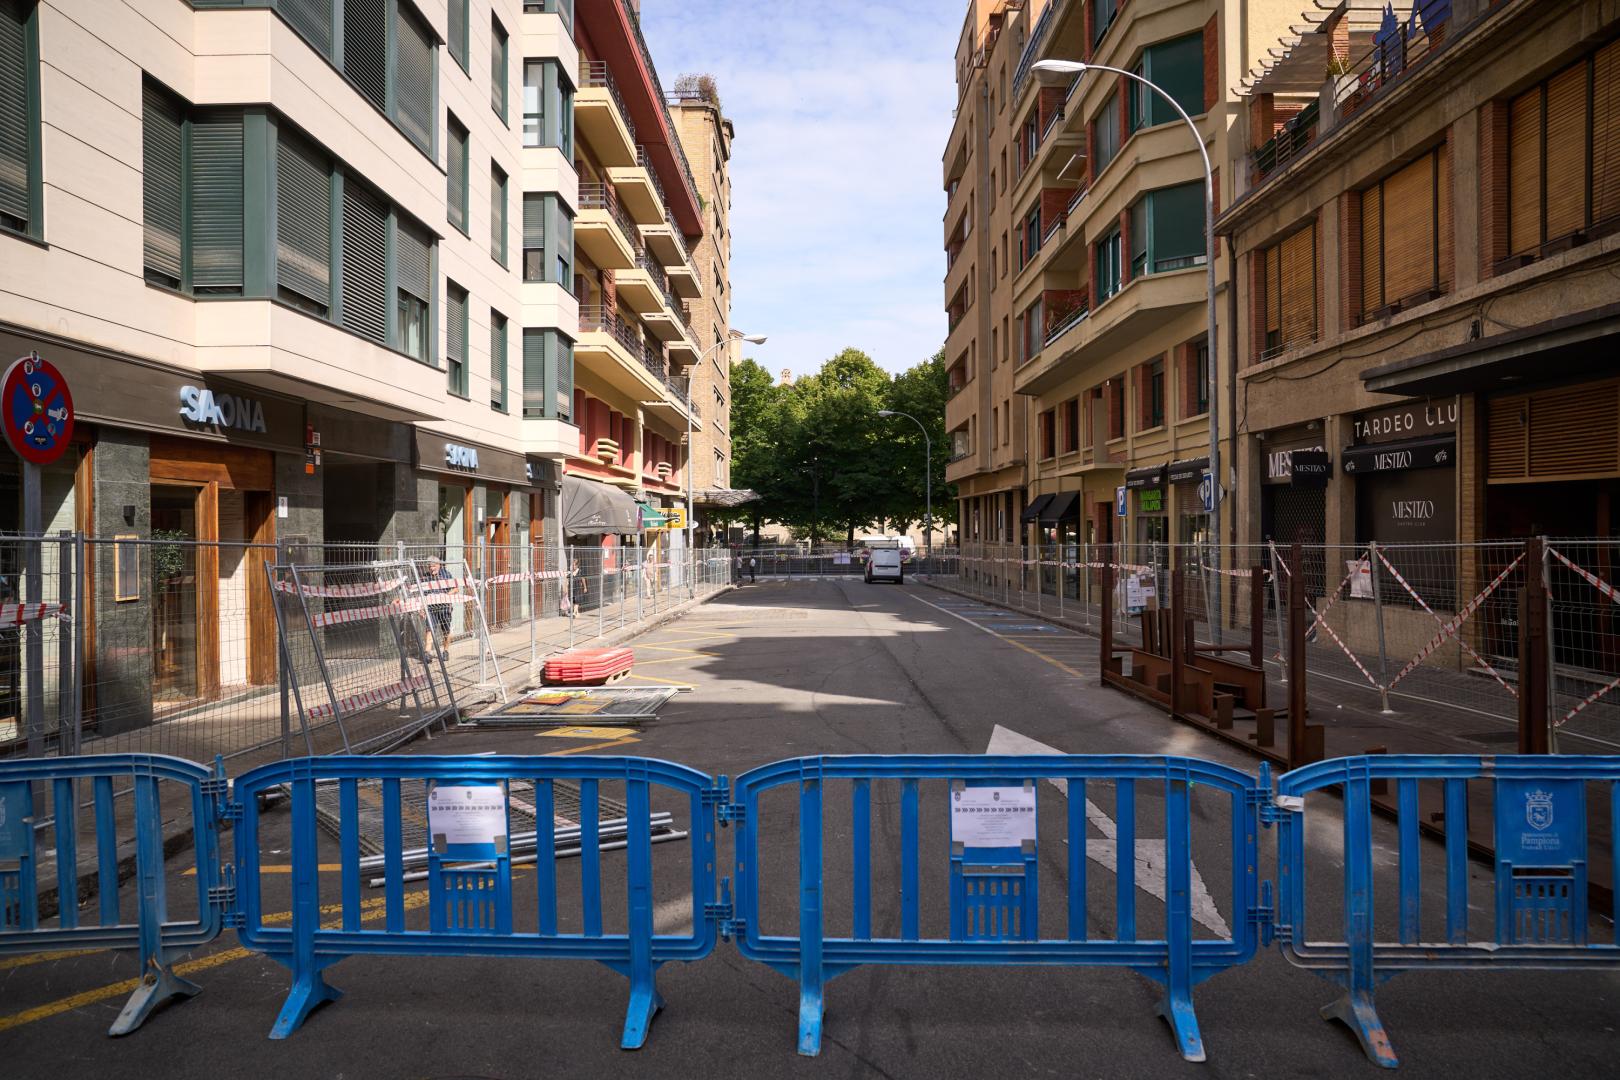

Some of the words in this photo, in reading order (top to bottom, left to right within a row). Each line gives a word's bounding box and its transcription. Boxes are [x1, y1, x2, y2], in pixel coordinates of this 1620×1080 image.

[180, 386, 267, 433] SAONA
[1354, 413, 1414, 438] TARDEO
[1295, 464, 1326, 473] MESTIZO
[1373, 450, 1412, 471] MESTIZO
[1392, 500, 1434, 519] MESTIZO
[1521, 836, 1560, 848] Pamplona
